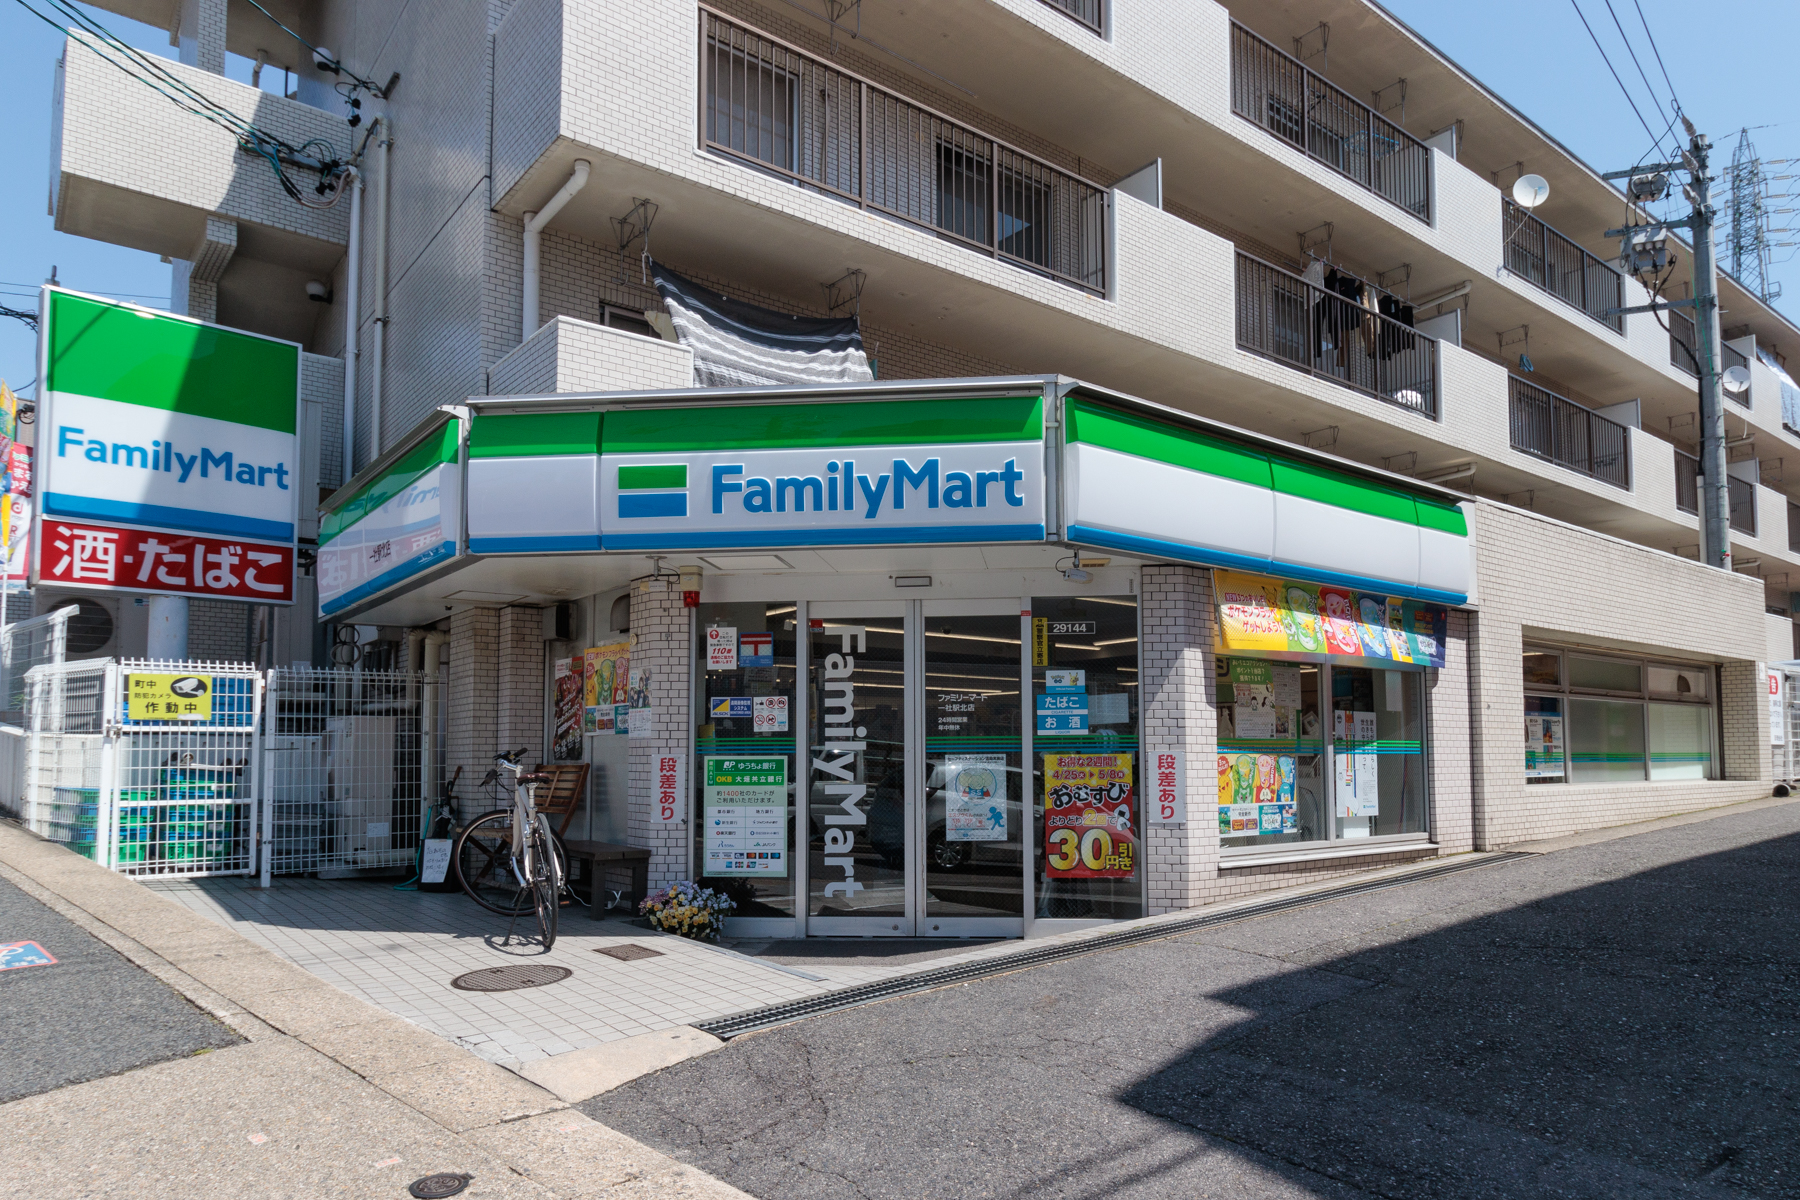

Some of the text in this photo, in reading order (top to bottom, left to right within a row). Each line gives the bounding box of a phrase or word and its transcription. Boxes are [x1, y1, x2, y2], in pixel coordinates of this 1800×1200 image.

[58, 425, 289, 490] FamilyMart
[712, 457, 1025, 519] FamilyMart
[1228, 605, 1278, 618] ポケモンフラッペ
[1053, 624, 1087, 632] 29144
[1243, 620, 1283, 633] ゲットしよう!
[135, 680, 156, 688] 町中
[938, 694, 988, 702] ファミリーマート
[1045, 696, 1079, 708] たばこ
[145, 702, 197, 714] 作動中
[938, 704, 975, 712] 一社駅北店
[1045, 716, 1080, 728] お 酒
[738, 762, 776, 770] ゆうちょ銀行
[811, 625, 867, 898] FamilyMart
[1057, 756, 1118, 768] お得な2週間!
[659, 757, 677, 820] 段差あり
[1157, 754, 1176, 819] 段差あり
[1048, 781, 1130, 810] おむすび
[1049, 808, 1118, 827] よりどり2個で
